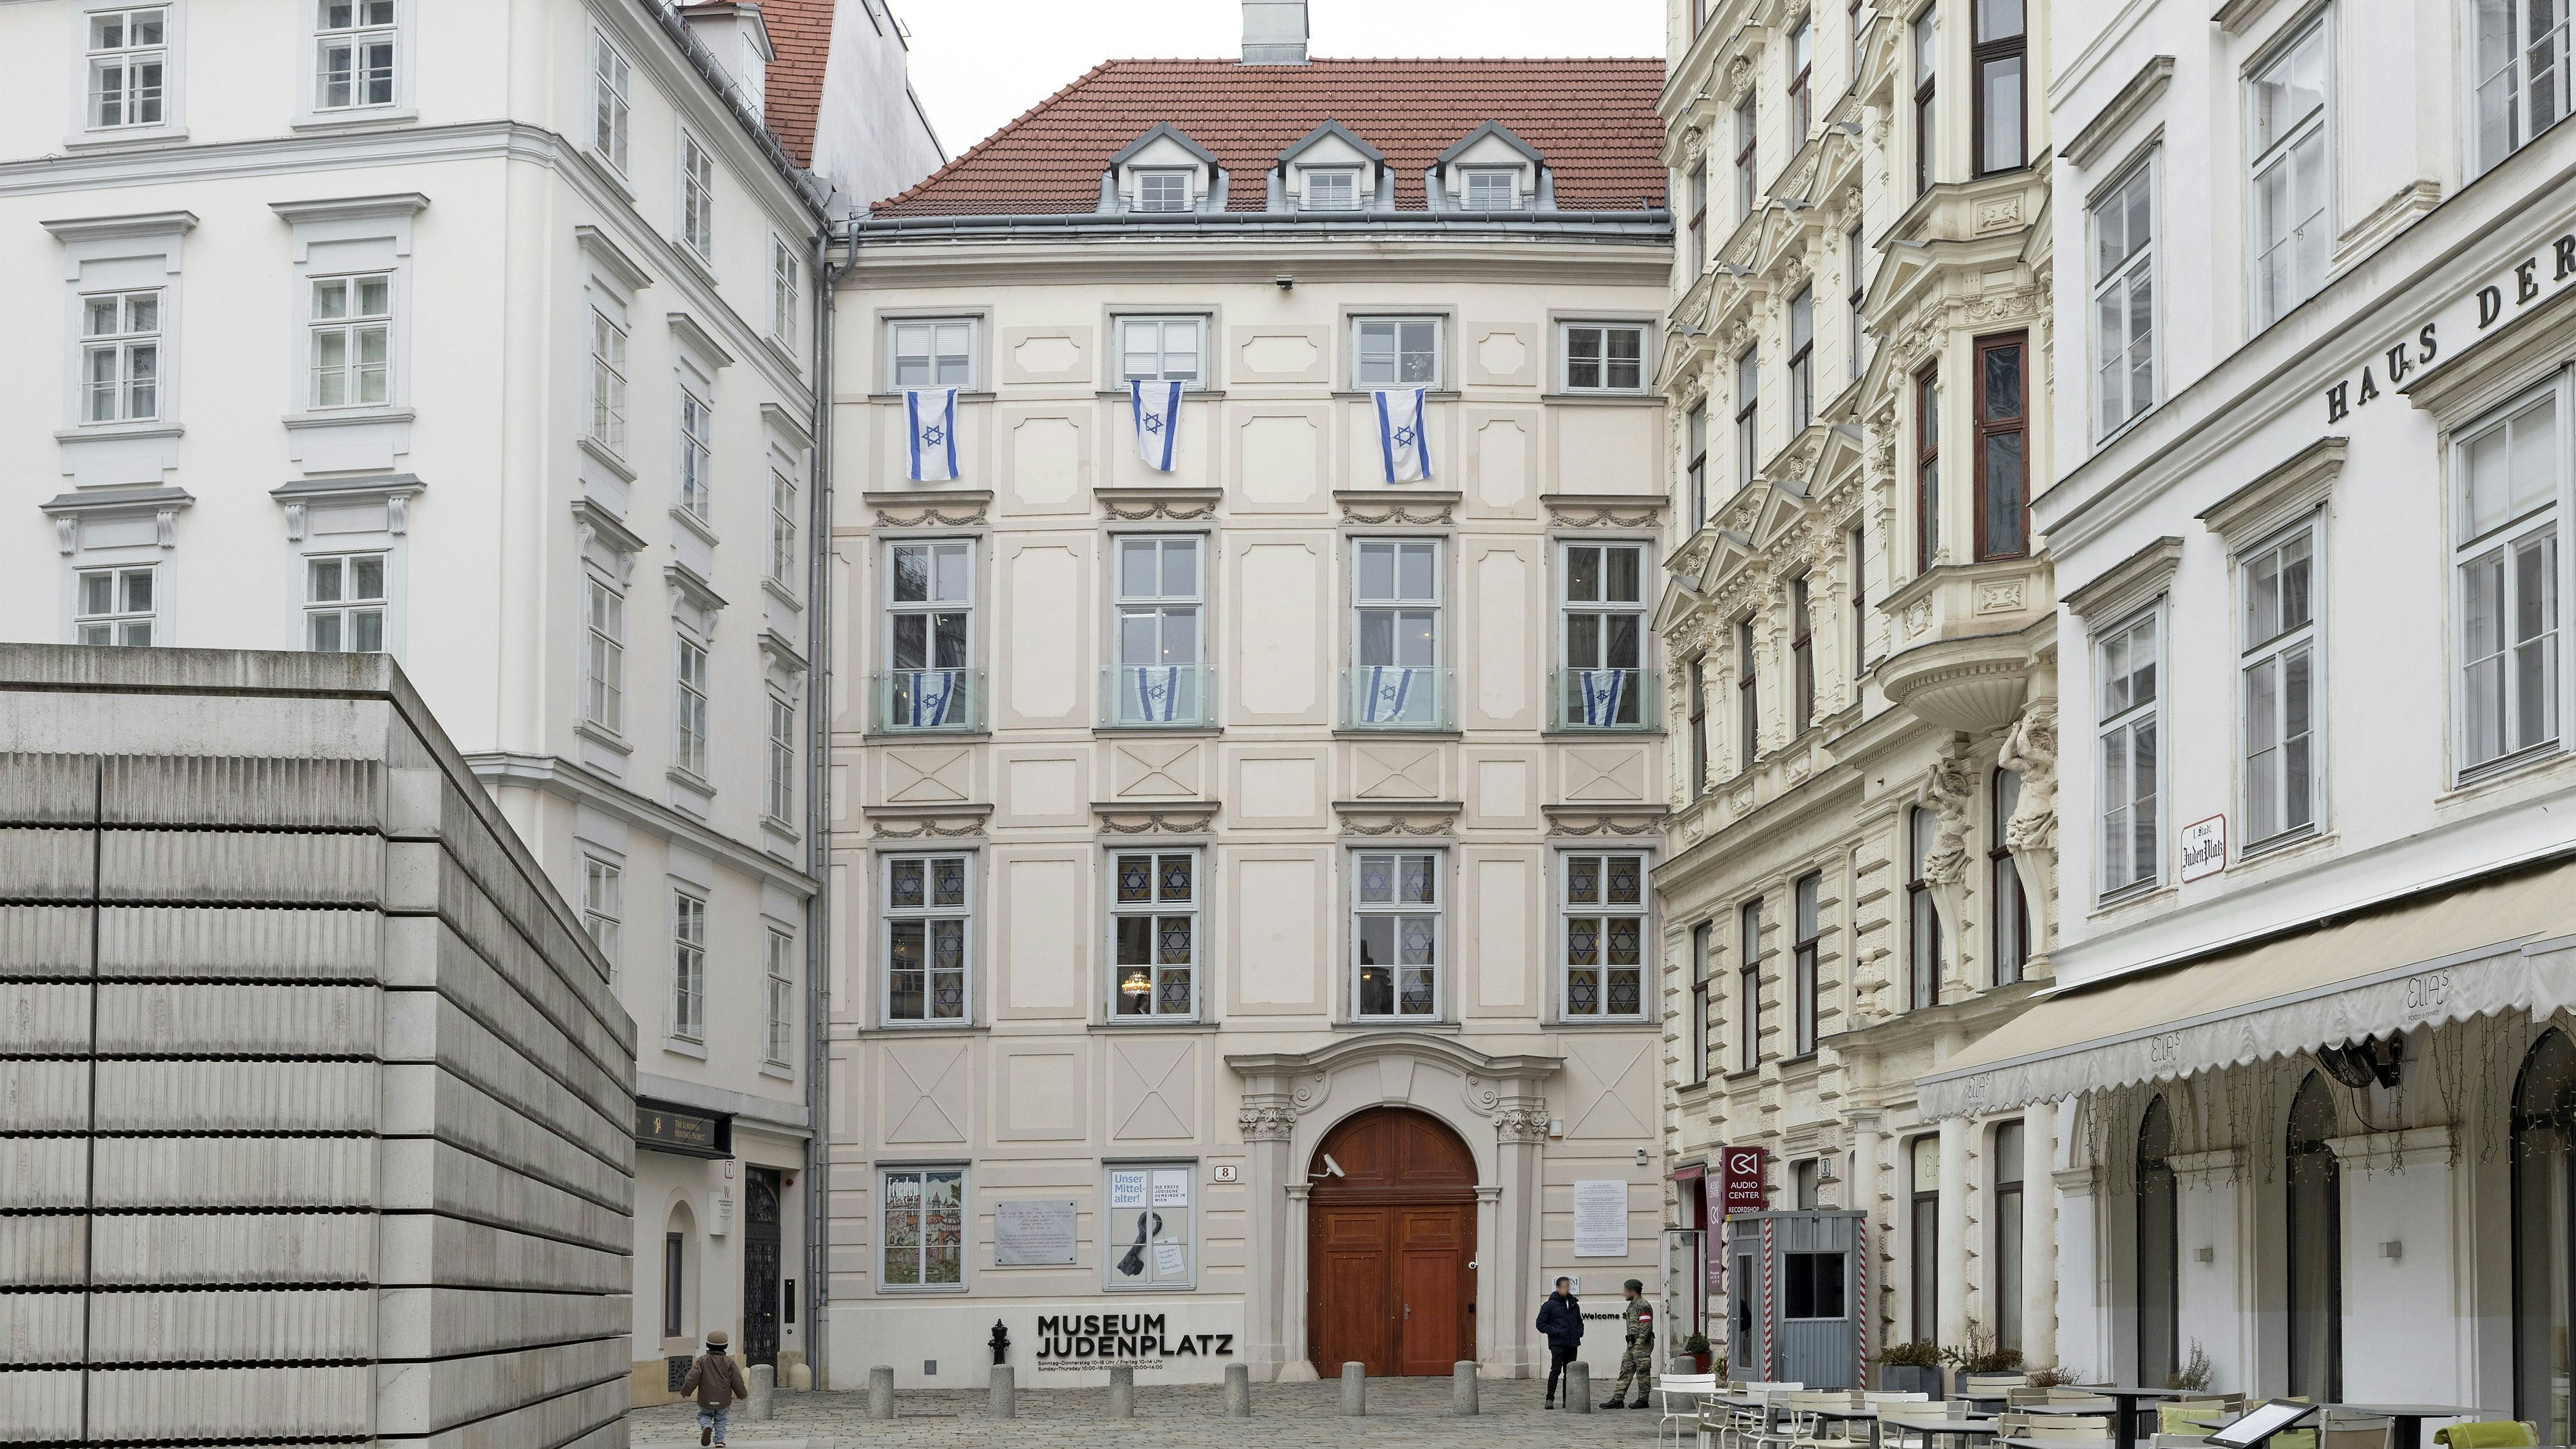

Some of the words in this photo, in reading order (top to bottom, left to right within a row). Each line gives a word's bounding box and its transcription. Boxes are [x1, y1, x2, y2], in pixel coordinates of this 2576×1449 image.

[2325, 323, 2437, 424] HAUS
[2476, 234, 2576, 329] DER
[1115, 1174, 1143, 1183] Unser
[1222, 1168, 1229, 1177] 8
[888, 1177, 918, 1197] Frieden
[1115, 1184, 1146, 1193] Mittel-
[1115, 1194, 1140, 1203] alter!
[1038, 1314, 1164, 1336] MUSEUM
[1036, 1334, 1233, 1357] JUDENPLATZ
